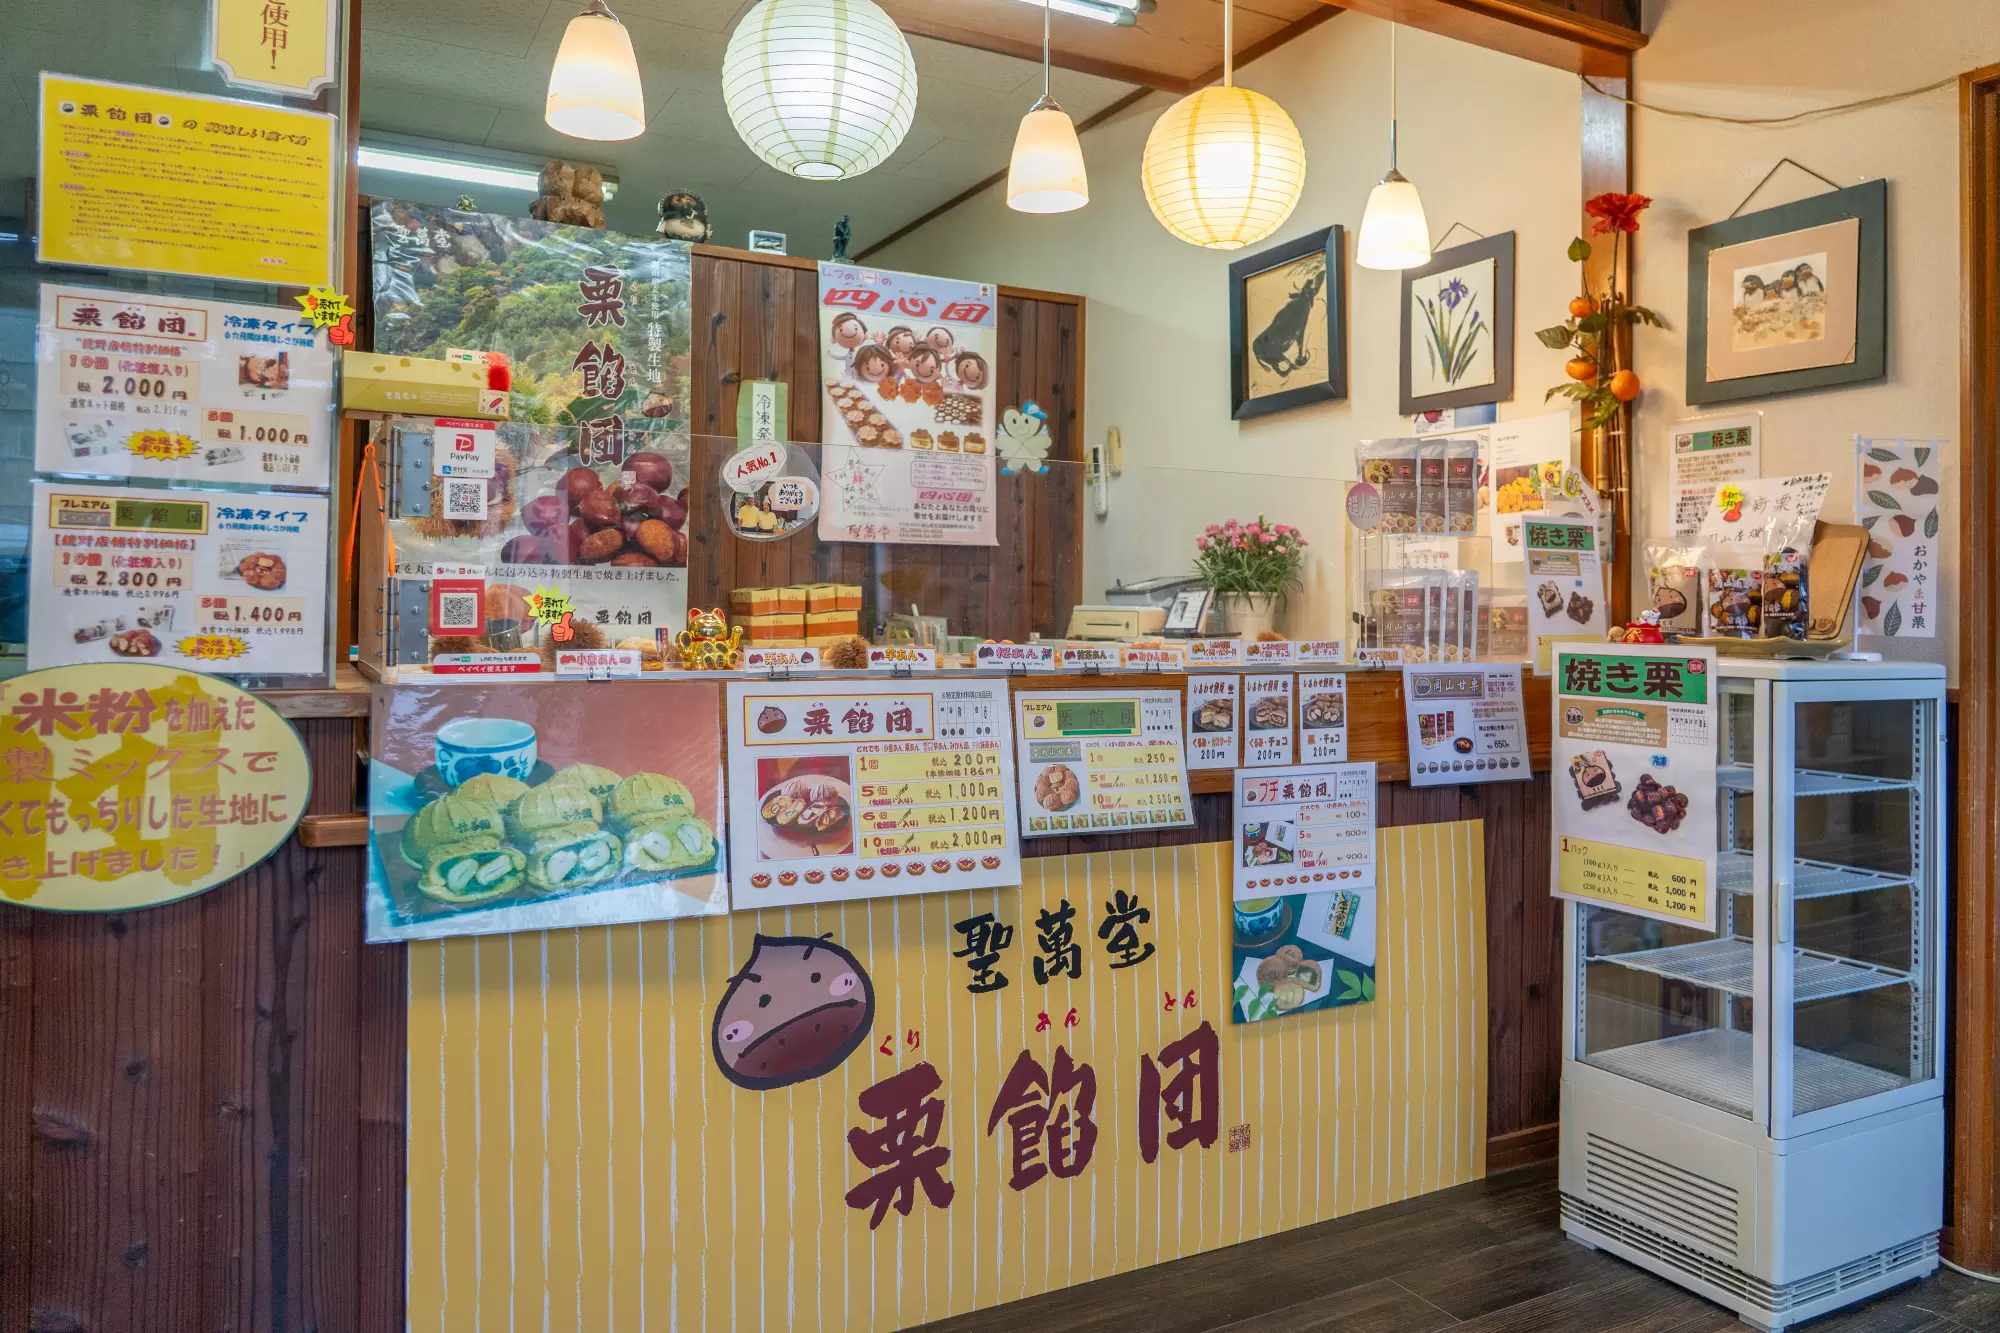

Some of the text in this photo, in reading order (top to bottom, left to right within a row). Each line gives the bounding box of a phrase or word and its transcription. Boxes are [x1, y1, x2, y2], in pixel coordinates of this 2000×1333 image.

[80, 104, 153, 124] 栗餡団
[182, 119, 198, 130] の
[72, 307, 186, 335] 栗餡団
[224, 315, 314, 335] 冷凍タイプ
[647, 322, 663, 384] 特製生地
[70, 354, 109, 370] 10個
[572, 263, 627, 467] 栗餡団
[207, 411, 234, 423] 5個
[1711, 428, 1749, 448] 焼き栗
[450, 452, 480, 462] PayPay
[60, 499, 111, 510] プレミアム
[216, 506, 309, 523] 冷凍タイプ
[1529, 525, 1585, 547] 焼き栗
[61, 552, 103, 567] 10個
[1911, 544, 1928, 630] おかやま甘栗
[201, 597, 227, 609] 5個
[576, 653, 618, 666] 小倉あん
[764, 652, 800, 665] 栗あん
[885, 648, 918, 661] 芋あん
[1433, 678, 1480, 693] 岡山甘栗
[1564, 658, 1685, 698] 焼き栗
[1023, 704, 1053, 712] プレミアム
[802, 707, 914, 736] 栗餡団
[1200, 750, 1225, 760] 200円
[1257, 750, 1281, 761] 200円
[1313, 746, 1337, 757] 200円
[859, 756, 879, 771] 1個
[861, 785, 888, 797] 5個
[1259, 780, 1327, 803] プチ 栗餡団
[863, 837, 895, 848] 10個
[952, 889, 1156, 994] 聖萬堂
[1165, 988, 1199, 1012] とん
[1034, 1007, 1081, 1033] あん
[879, 1029, 921, 1057] くり
[844, 1020, 1221, 1231] 栗餡団
